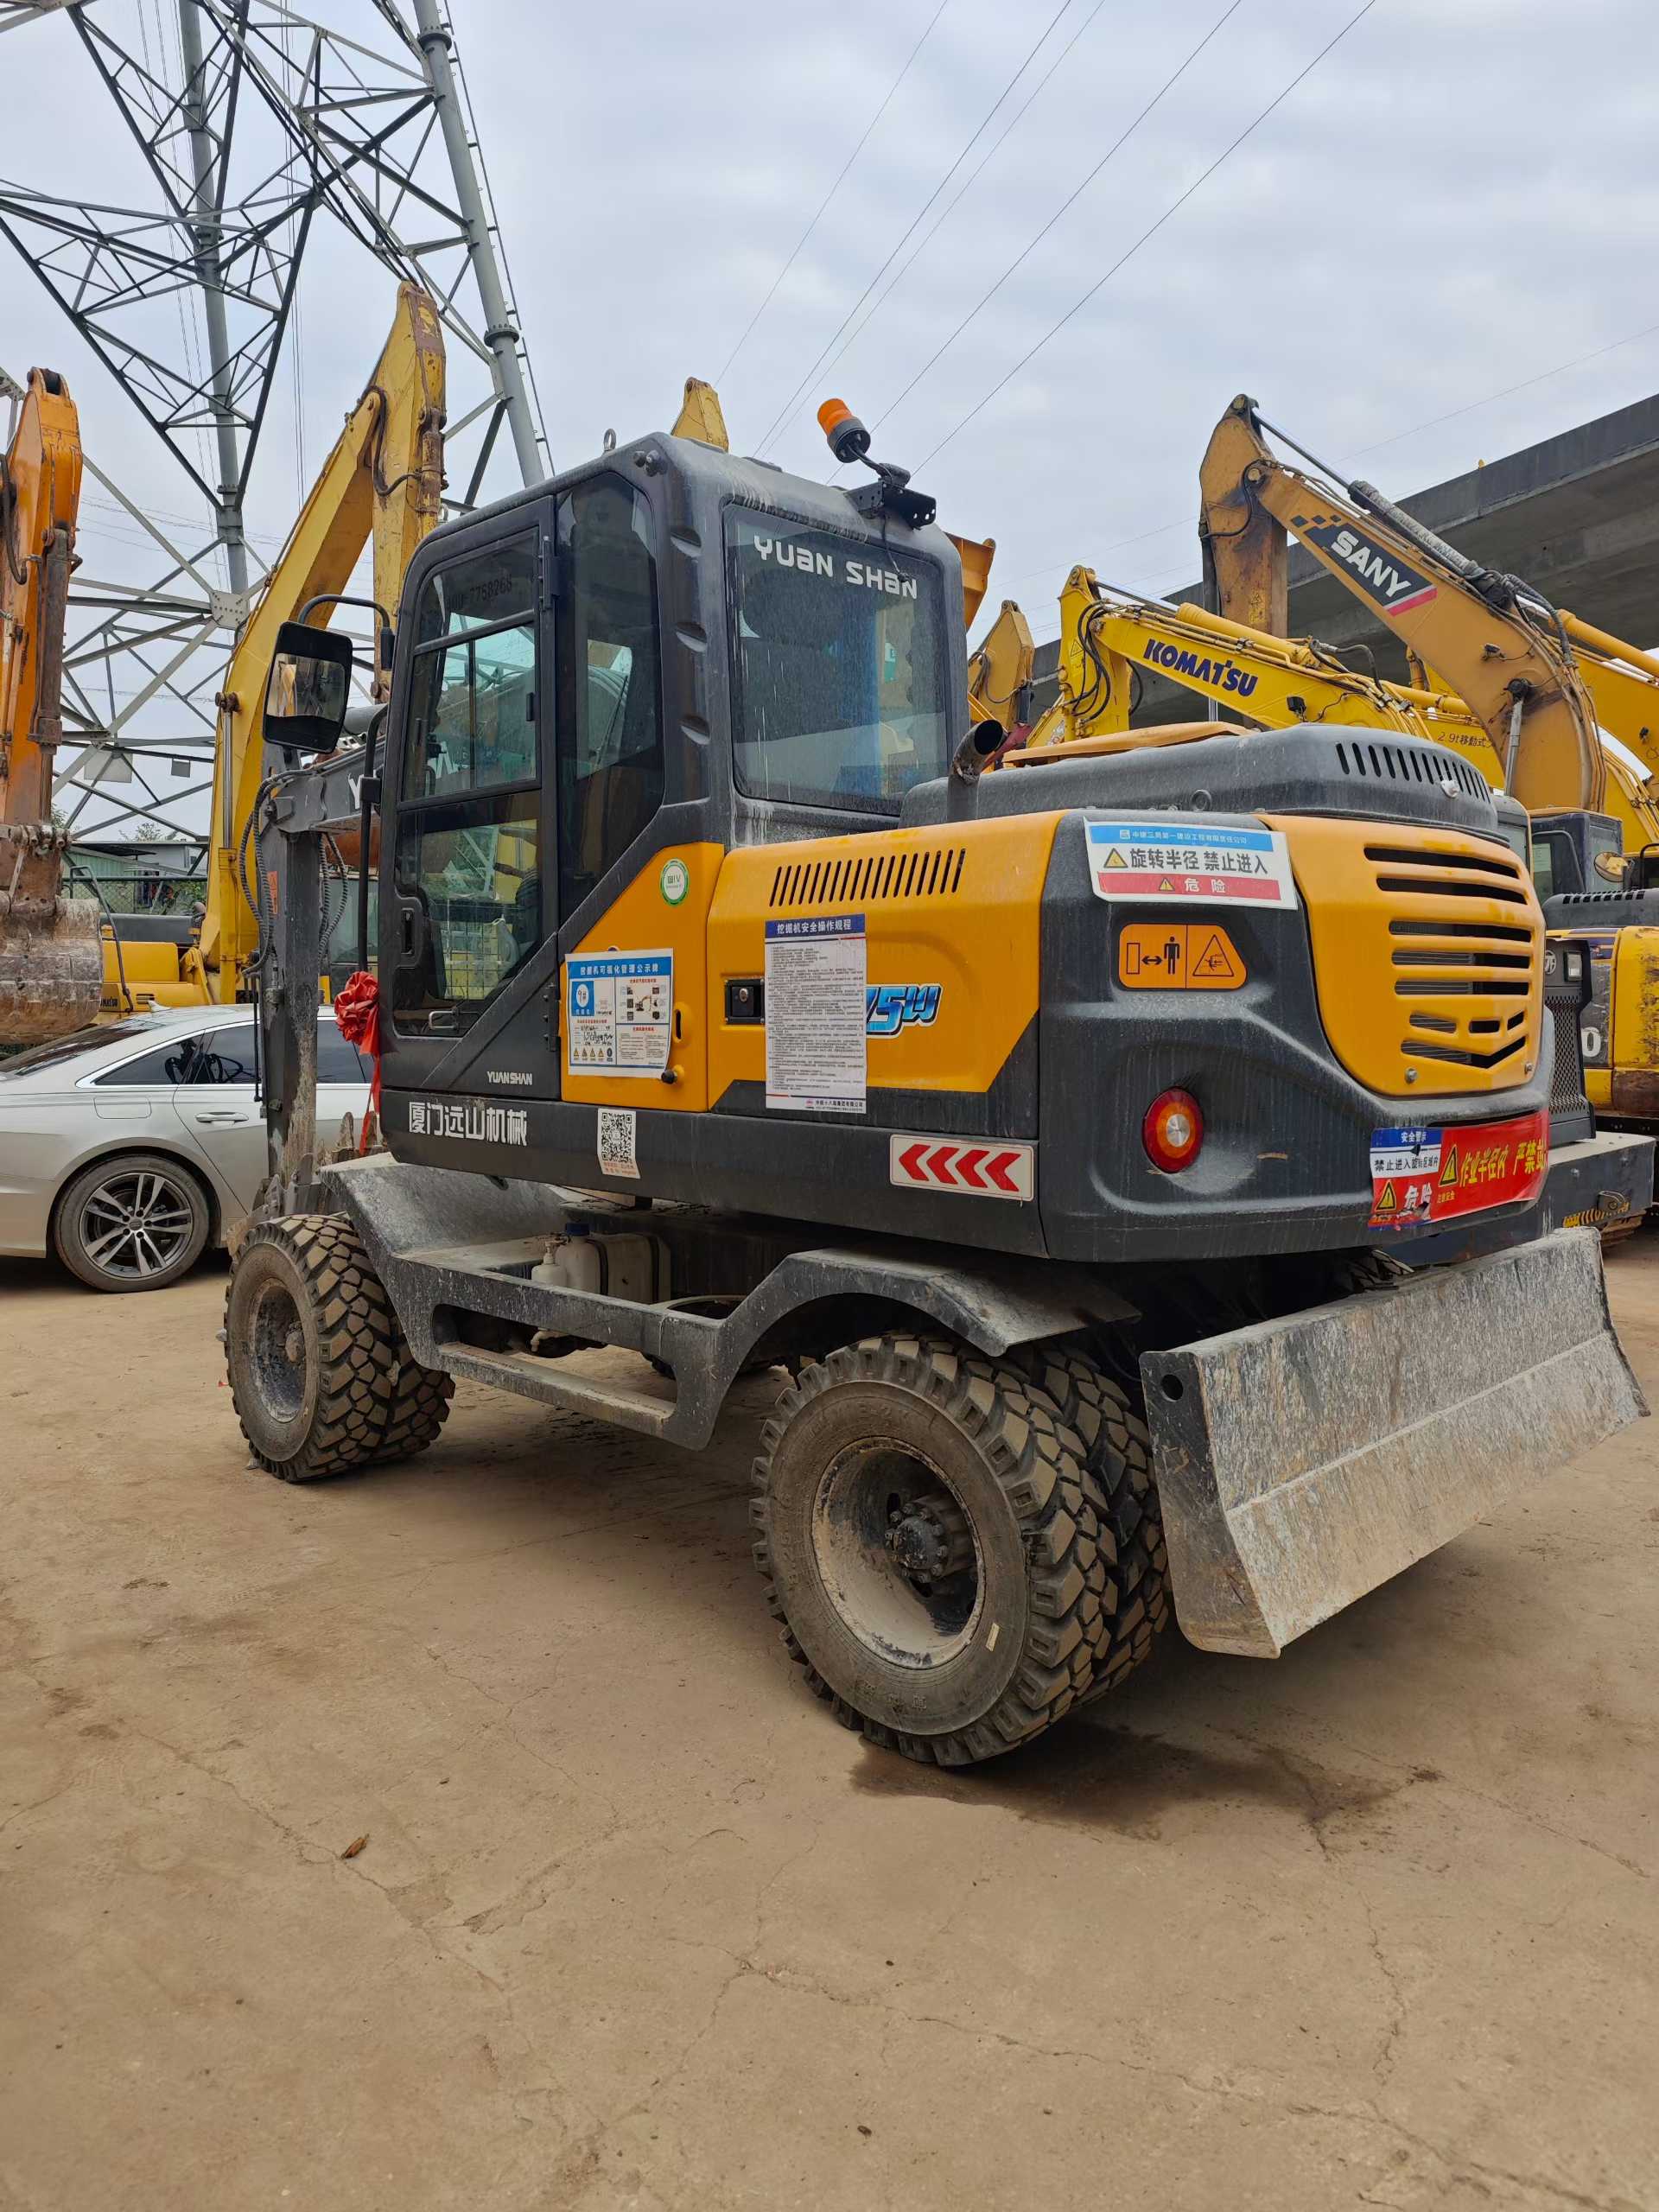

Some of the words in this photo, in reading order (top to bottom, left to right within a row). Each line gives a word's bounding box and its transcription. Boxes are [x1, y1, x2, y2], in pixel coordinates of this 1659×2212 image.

[1331, 530, 1412, 599] SANY
[1143, 638, 1259, 697] KOMATSU
[1130, 848, 1199, 871] 旋转半径
[1203, 851, 1268, 874] 禁止进入
[1185, 878, 1227, 893] 危险
[777, 918, 851, 935] 挖掘机安全操作规程
[486, 1071, 532, 1085] YUANSHAN
[409, 1101, 527, 1147] 厦门远山机械
